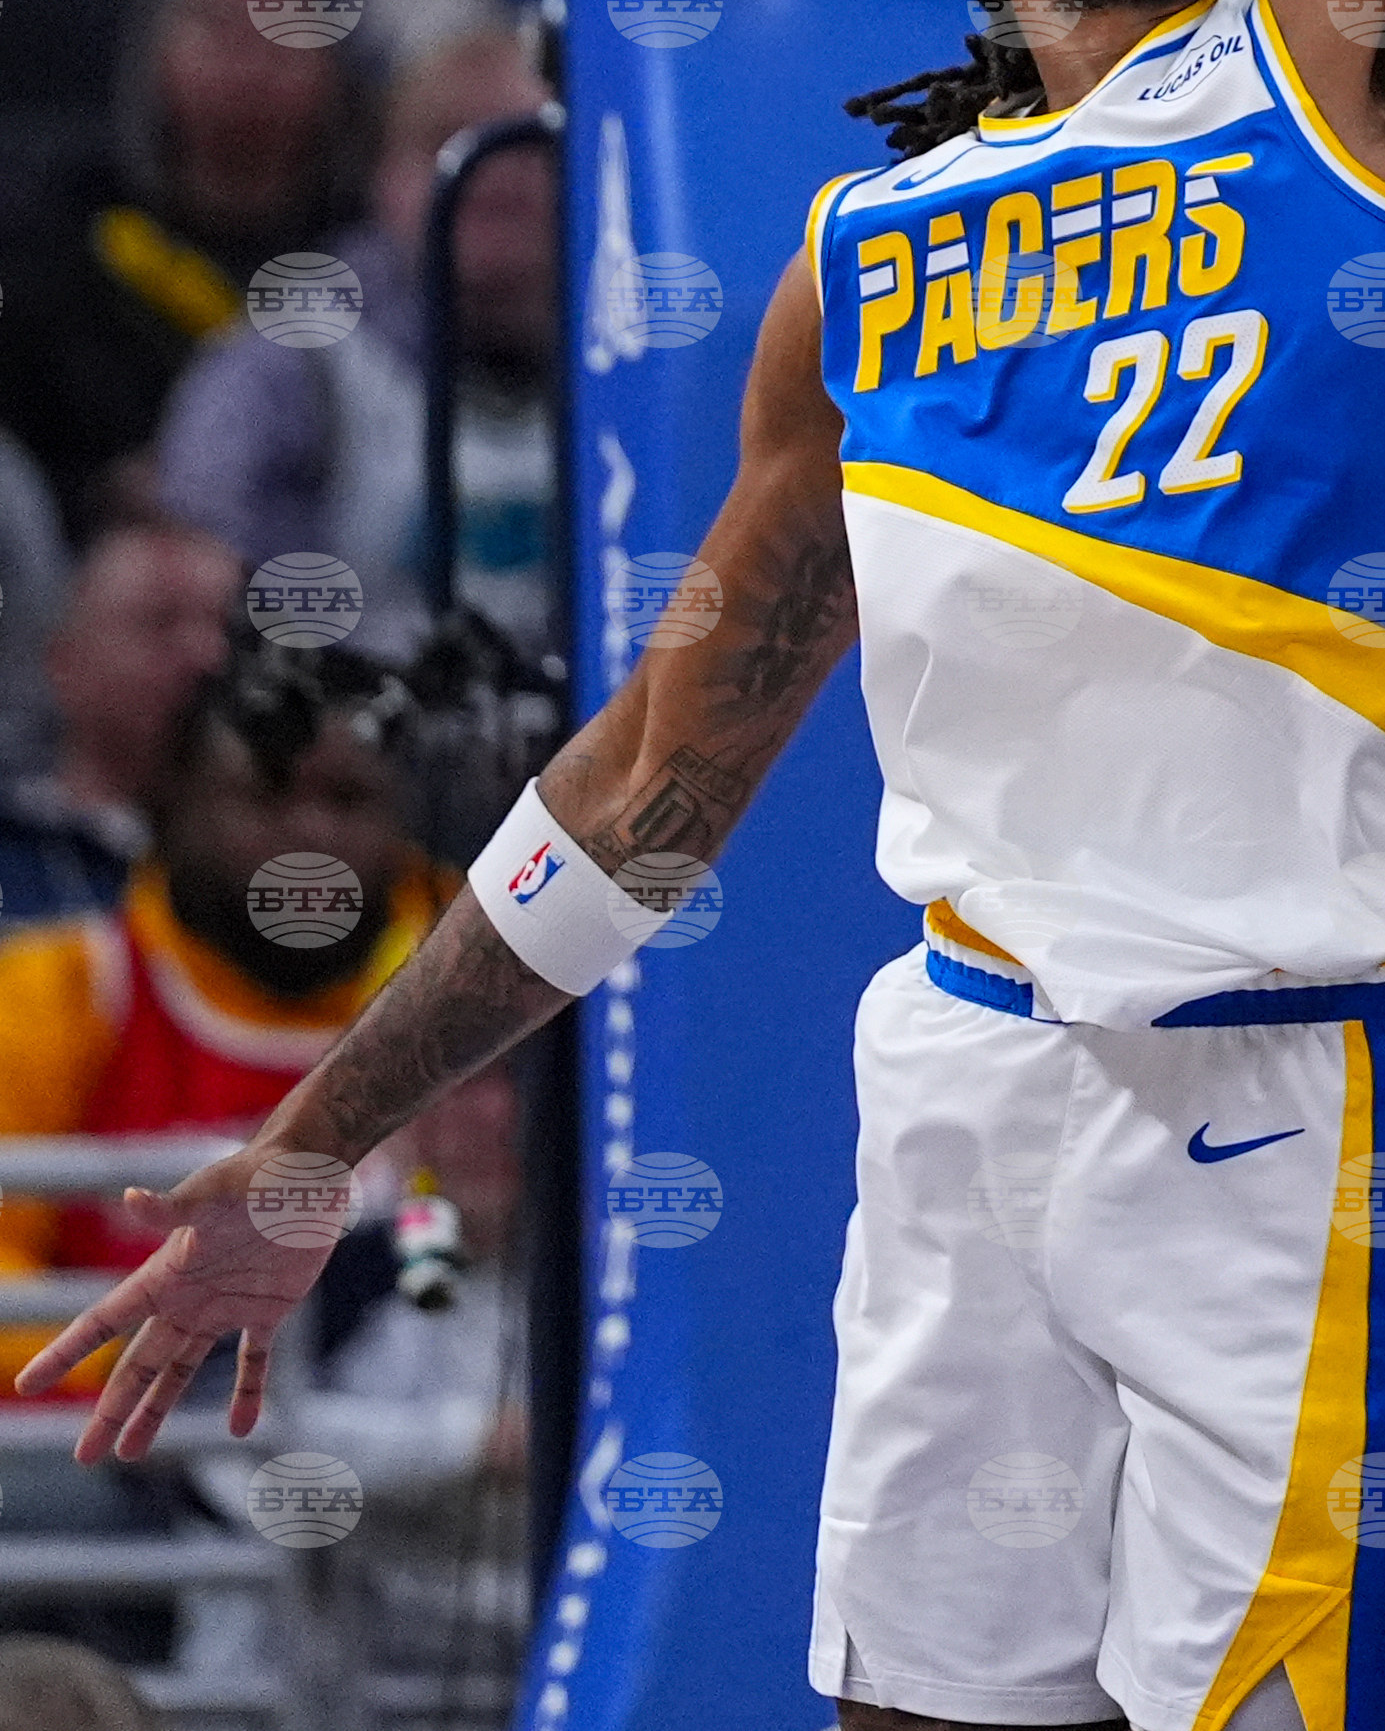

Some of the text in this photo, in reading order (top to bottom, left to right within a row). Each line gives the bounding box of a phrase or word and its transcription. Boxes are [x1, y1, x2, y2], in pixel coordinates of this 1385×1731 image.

[1137, 35, 1245, 100] LUCAS OIL
[853, 152, 1254, 393] PACERS
[1061, 308, 1269, 515] 22
